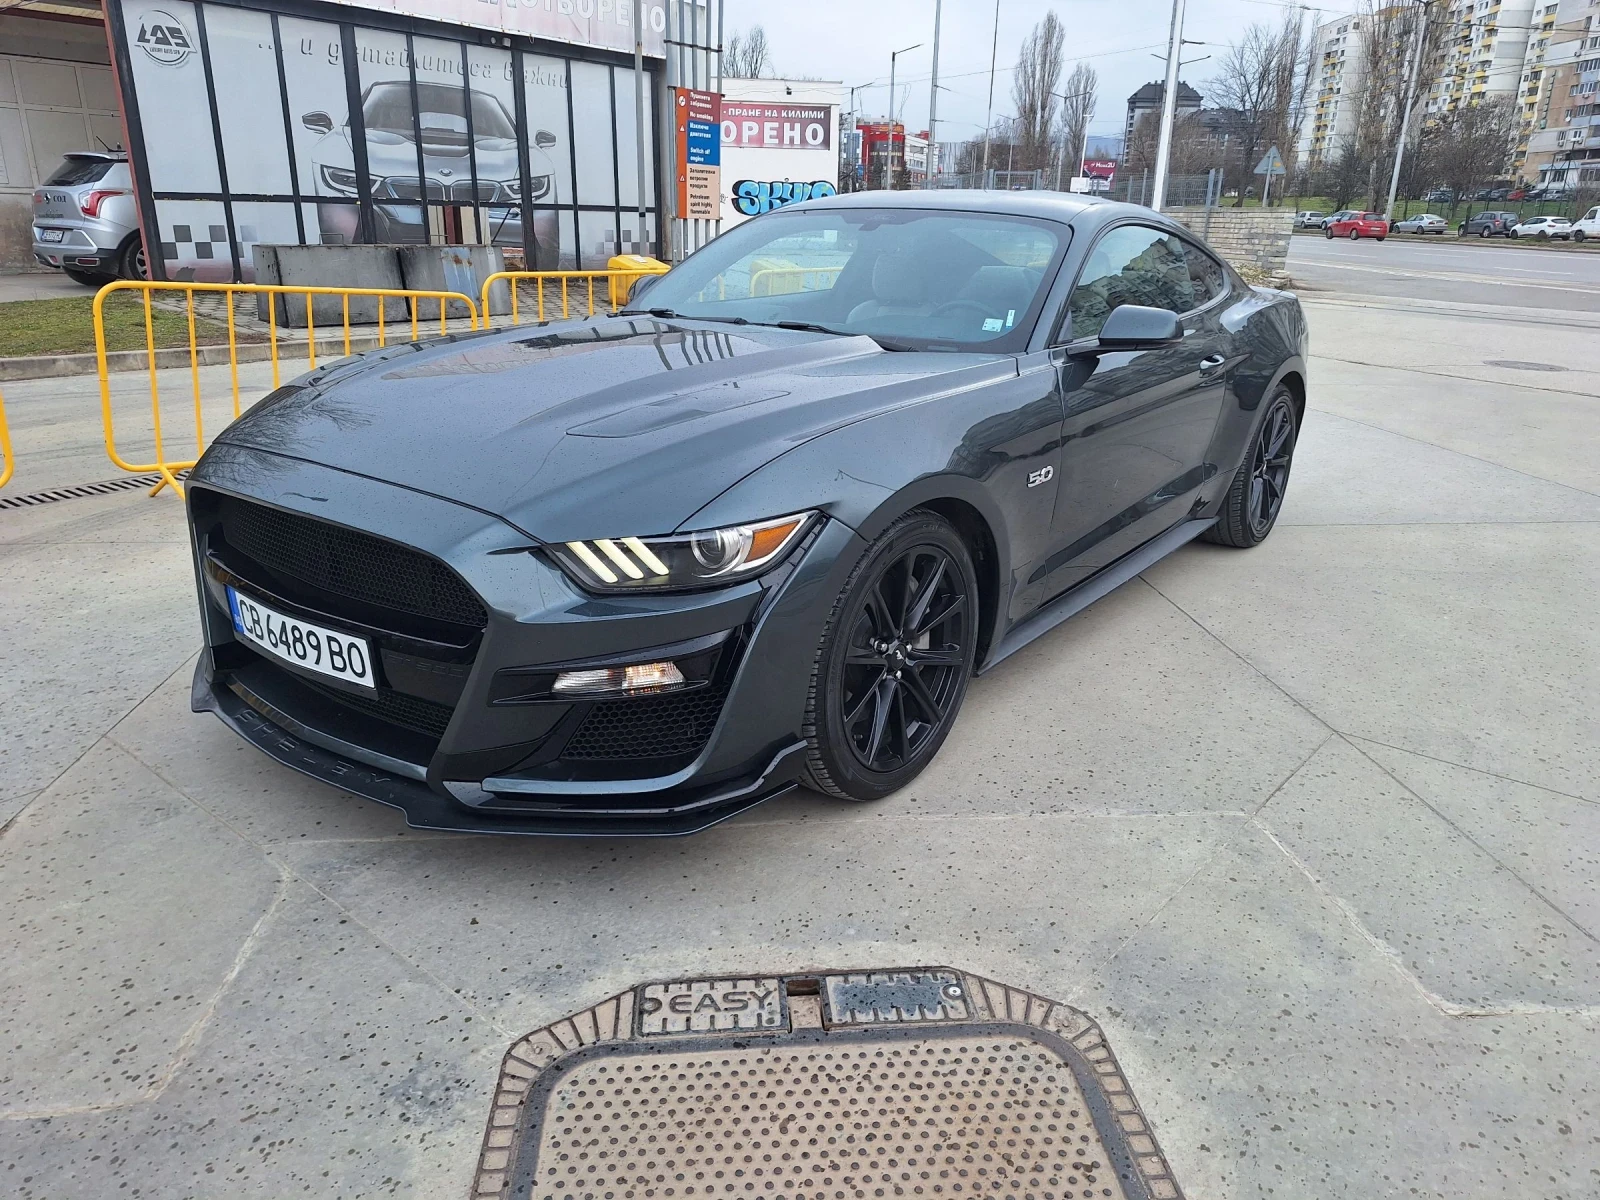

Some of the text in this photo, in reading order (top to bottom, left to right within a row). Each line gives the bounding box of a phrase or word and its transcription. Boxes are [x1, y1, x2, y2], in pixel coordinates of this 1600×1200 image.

[137, 23, 190, 48] LAS
[728, 108, 825, 119] ПРАНЕ НА КИЛИМИ
[266, 614, 321, 665] 6489
[670, 991, 771, 1014] EASY
